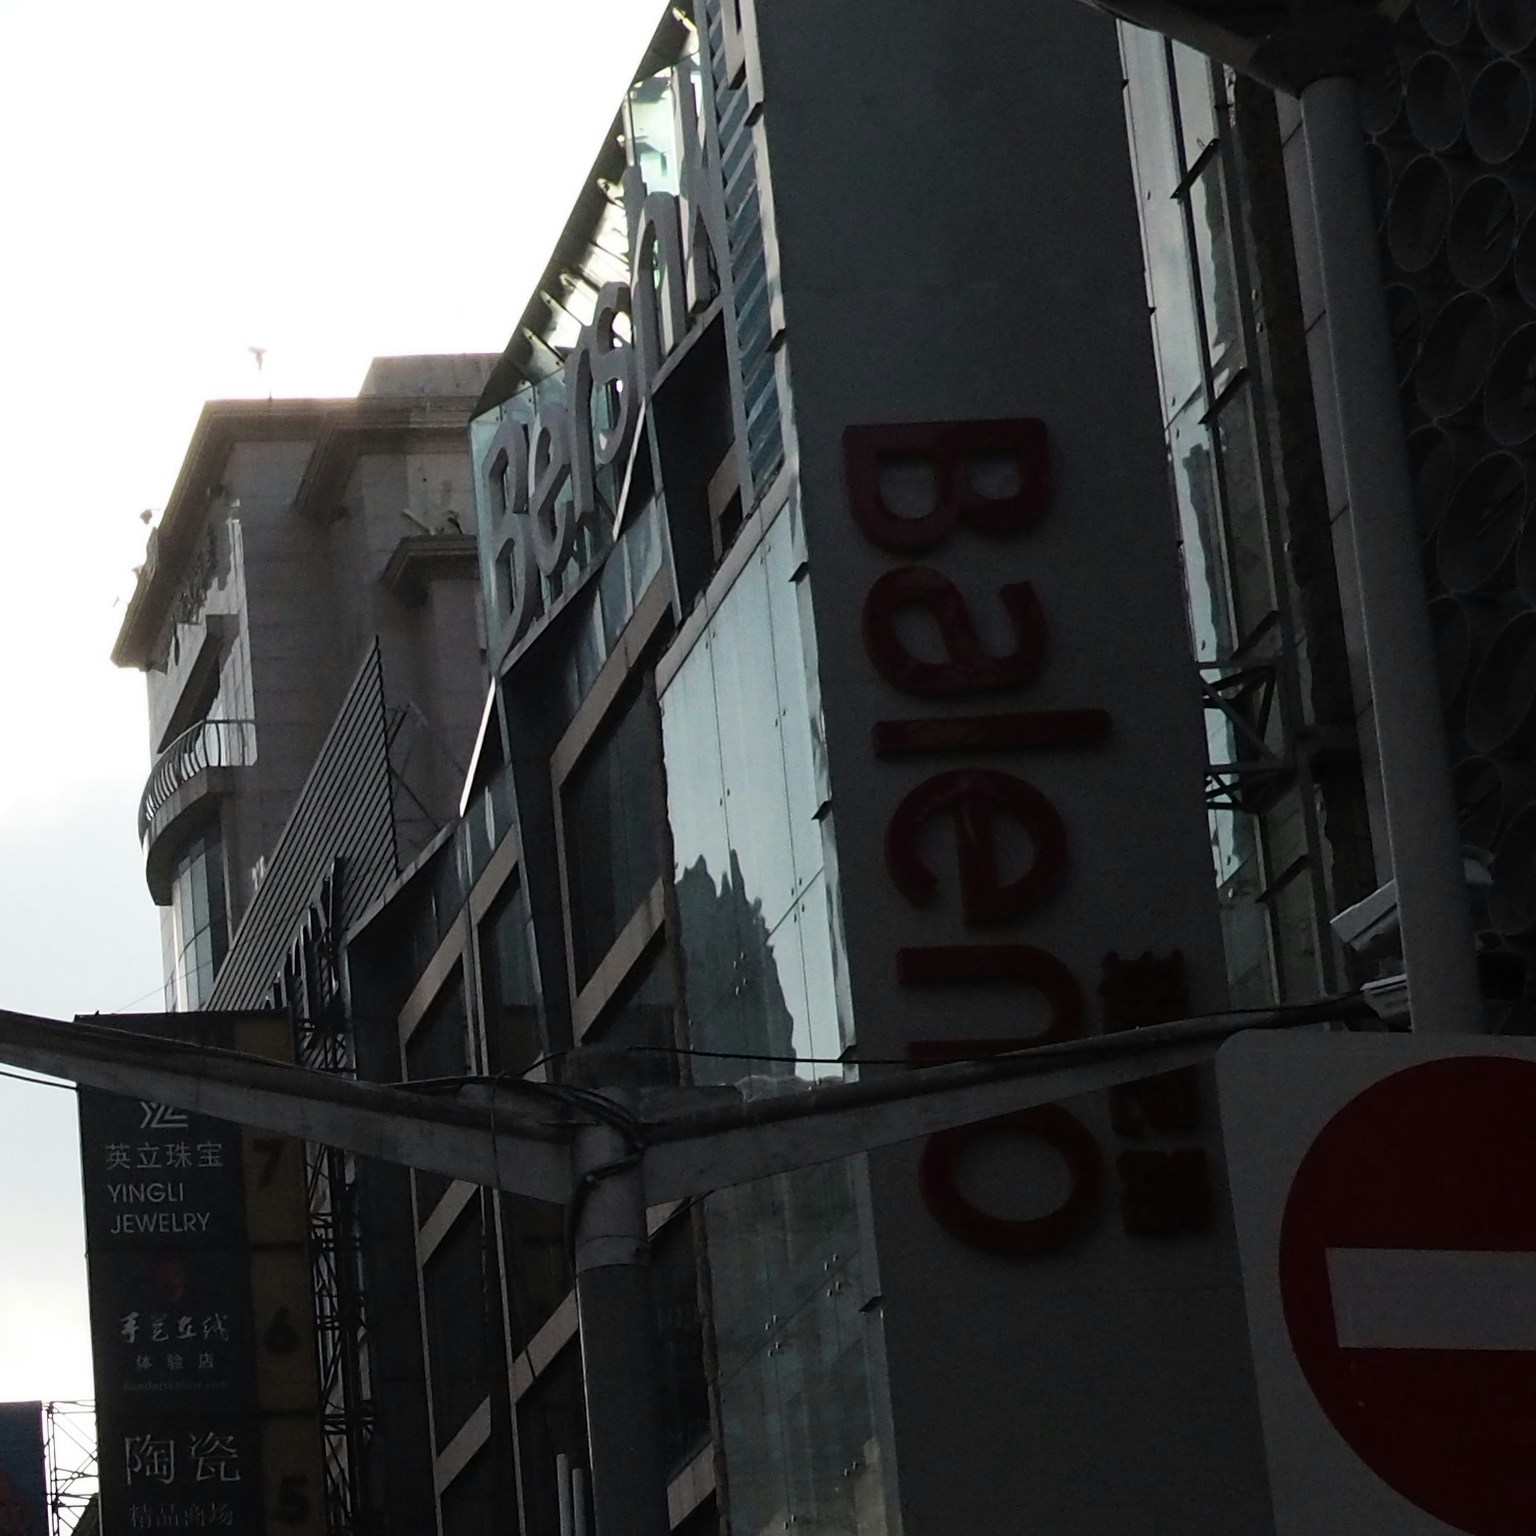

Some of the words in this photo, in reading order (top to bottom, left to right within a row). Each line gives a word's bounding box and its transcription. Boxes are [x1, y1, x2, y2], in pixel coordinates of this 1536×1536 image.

[840, 417, 1111, 1259] Baleno
[103, 1141, 224, 1170] 英立珠宝
[107, 1181, 185, 1203] YINGLI
[110, 1212, 211, 1235] JEWELRY
[123, 1430, 242, 1487] 陶瓷
